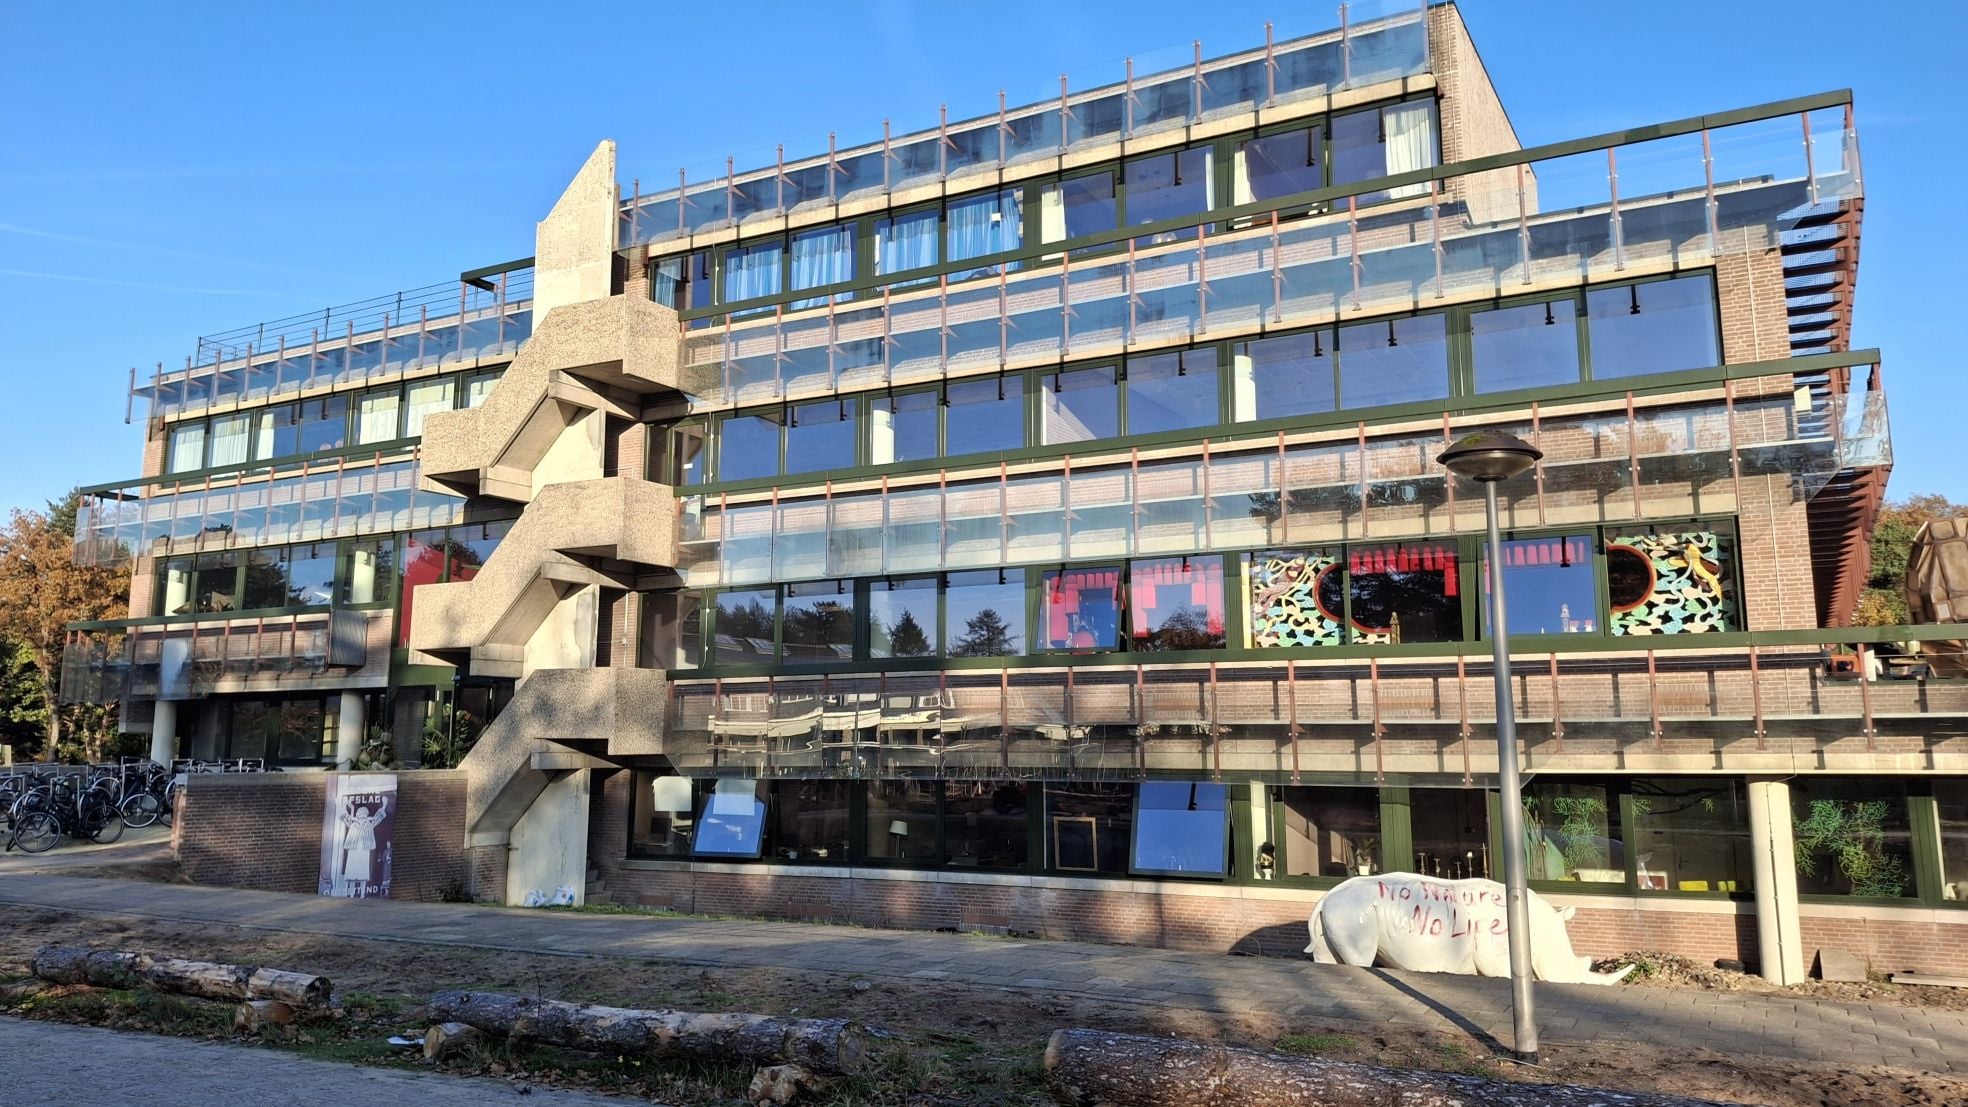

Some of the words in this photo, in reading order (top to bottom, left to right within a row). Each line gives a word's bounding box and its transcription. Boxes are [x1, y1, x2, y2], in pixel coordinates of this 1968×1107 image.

[343, 795, 381, 804] FSLAG
[1378, 881, 1411, 901] No
[1408, 904, 1442, 936] No
